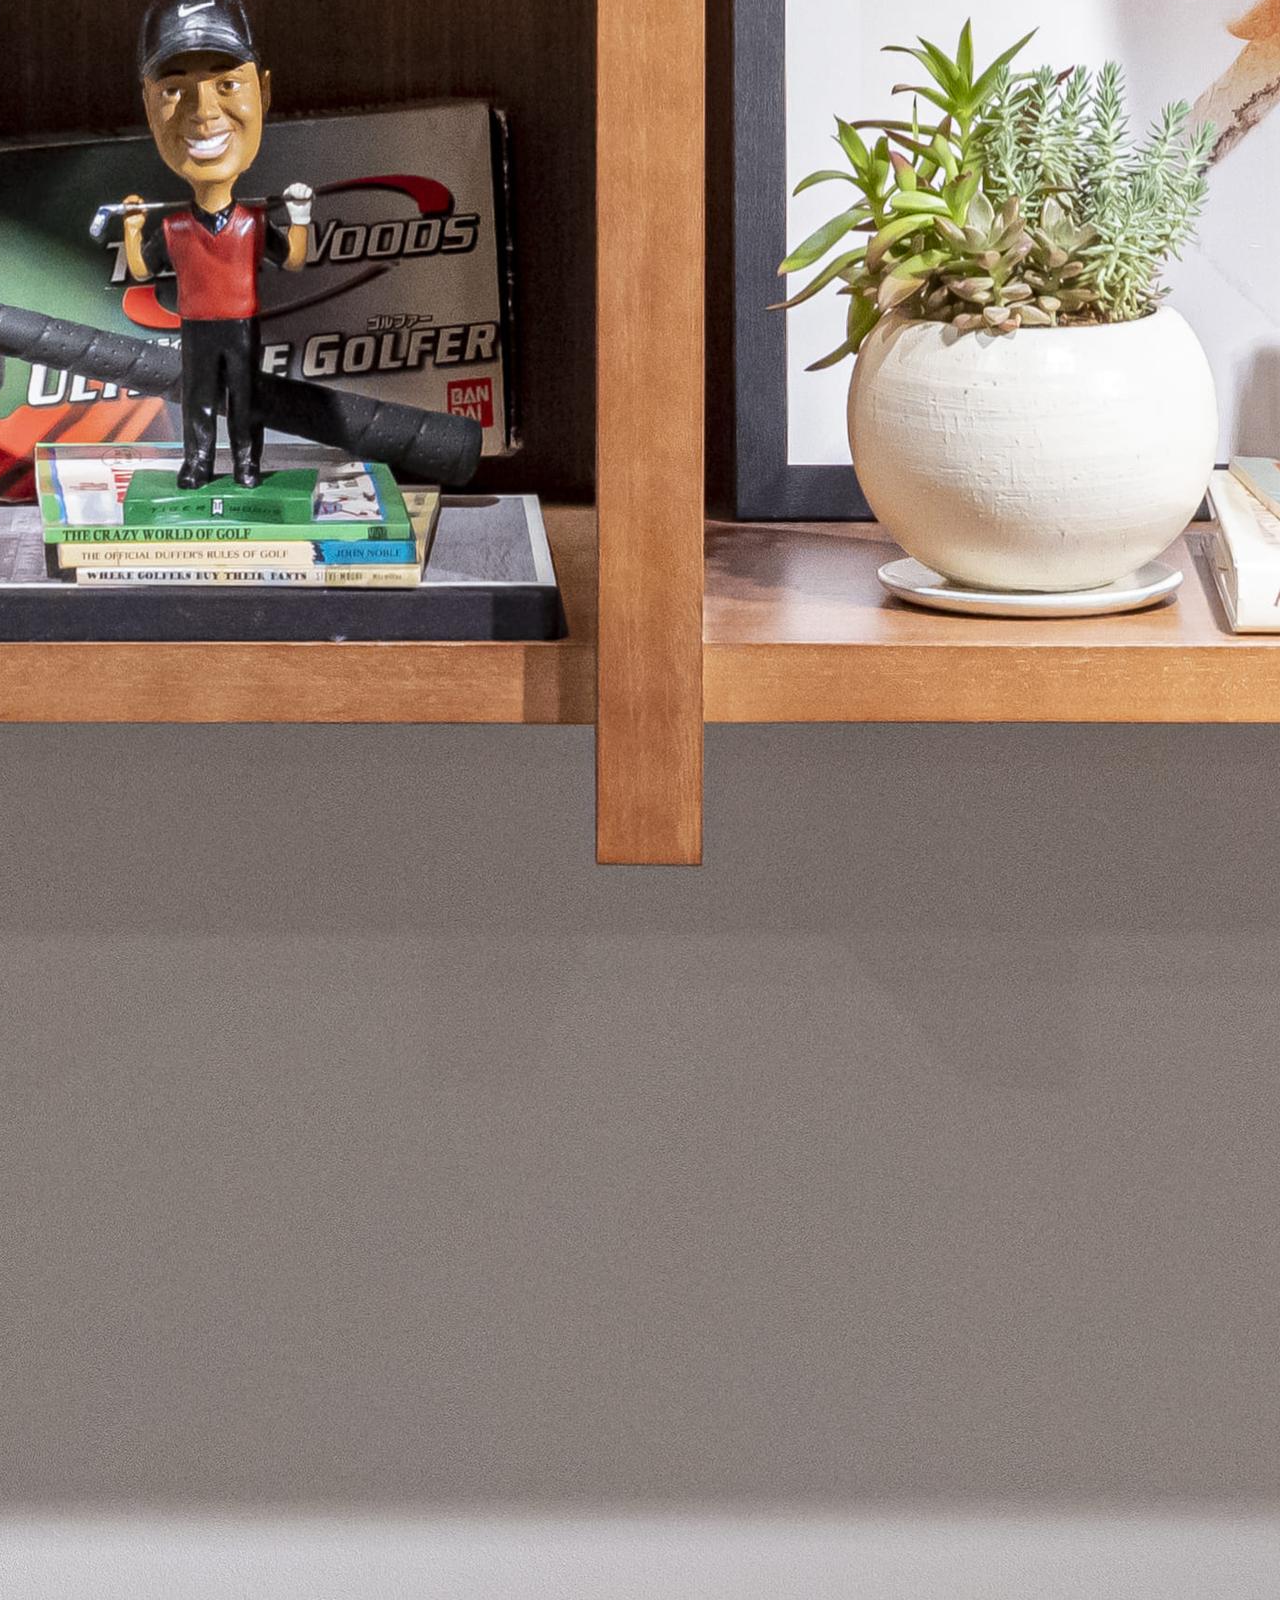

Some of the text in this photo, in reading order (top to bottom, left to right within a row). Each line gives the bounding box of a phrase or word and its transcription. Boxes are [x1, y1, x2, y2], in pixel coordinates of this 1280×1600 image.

[302, 322, 498, 379] GOLFER
[451, 387, 490, 405] BAN
[62, 528, 252, 542] THE CRAZY WORLD OF GOLF
[81, 552, 100, 560] THE
[104, 551, 150, 560] OFFICIAL
[207, 550, 240, 559] RULES
[243, 550, 257, 559] OF
[260, 550, 288, 559] GOLF
[335, 549, 363, 558] JOHN
[87, 571, 134, 580] WHERE
[137, 571, 192, 580] GOLFERS
[196, 571, 219, 580] BUY
[223, 571, 268, 580] THEIR
[271, 571, 308, 580] PANTS
